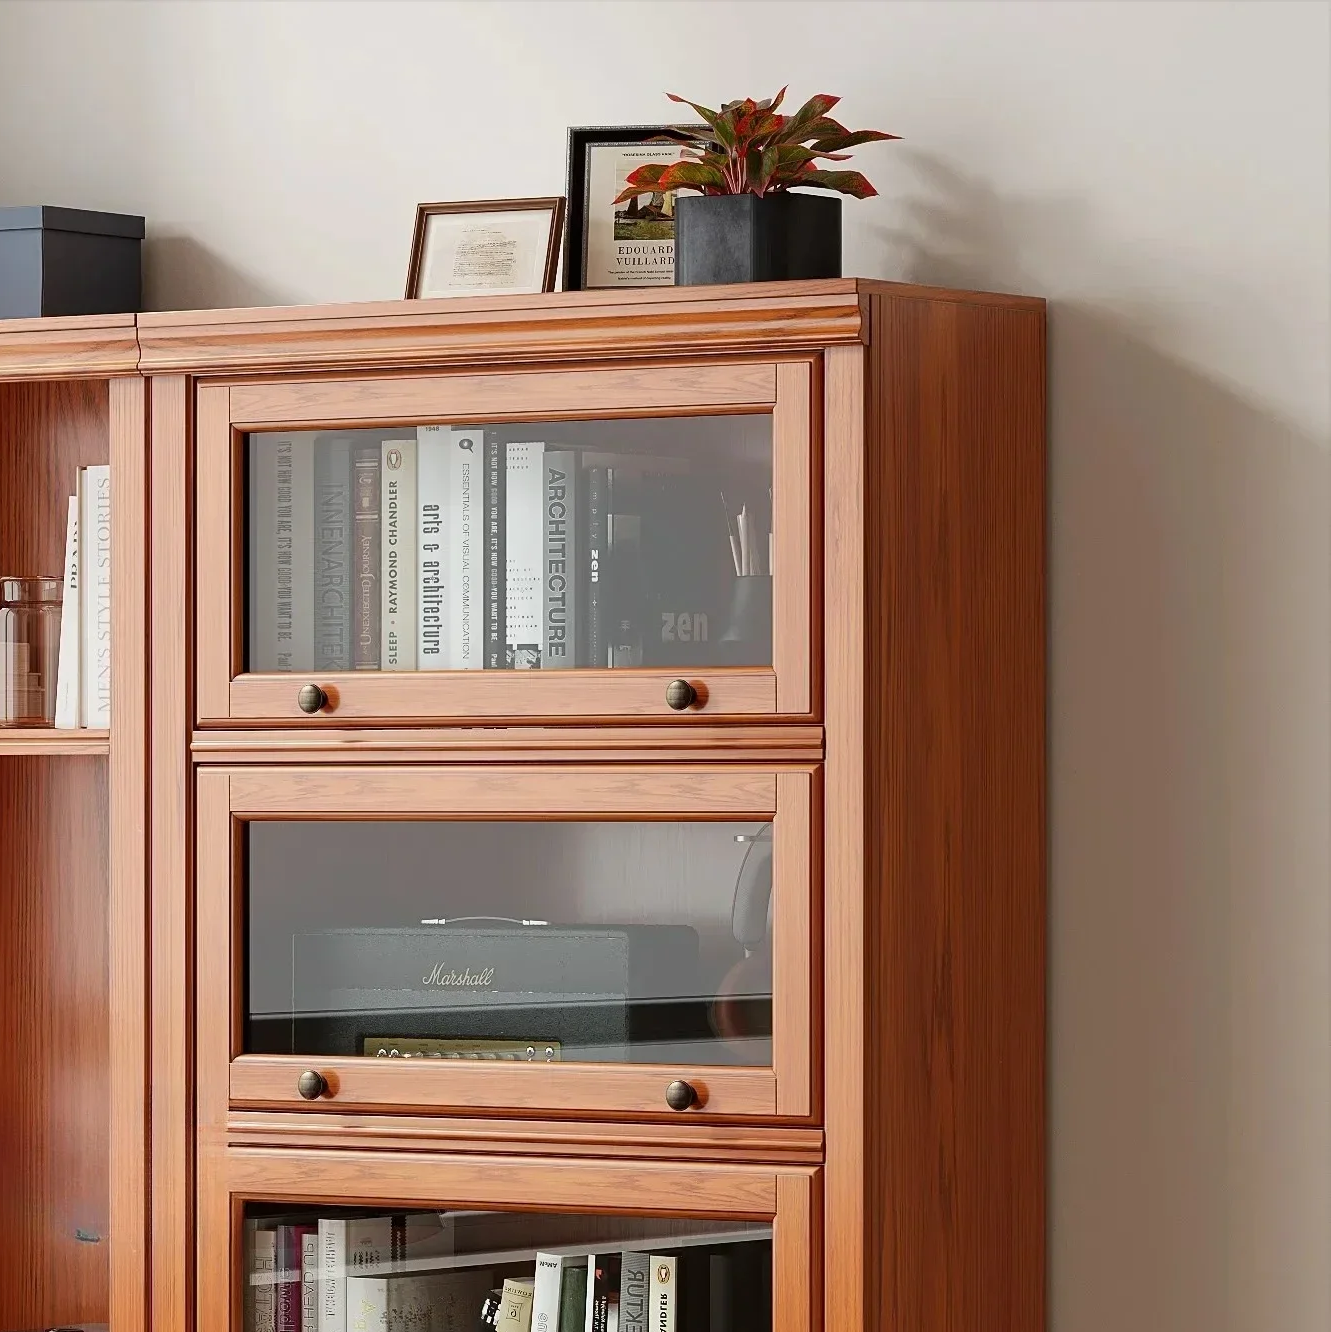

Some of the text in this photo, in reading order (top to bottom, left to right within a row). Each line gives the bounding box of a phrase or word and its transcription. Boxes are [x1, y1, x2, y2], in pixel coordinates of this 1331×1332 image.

[618, 245, 674, 255] EDOUARD
[616, 256, 675, 266] VUILLARD
[490, 442, 498, 455] IT'S
[276, 455, 293, 467] NOT
[490, 457, 498, 469] NOT
[276, 469, 293, 484] HOW
[490, 471, 498, 486] HOW
[276, 486, 293, 502] GOOD
[276, 506, 293, 518] YOU
[422, 504, 444, 534] arts
[490, 507, 498, 519] YOU
[276, 520, 293, 534] ARE,
[490, 521, 498, 536] ARE,
[490, 538, 498, 550] IT'S
[276, 551, 293, 565] HOW
[462, 463, 470, 660] ESSENTIALS OF VISUAL COMMUNICATION
[490, 552, 498, 566] HOW
[547, 467, 566, 657] ARCHITECTURE
[388, 480, 398, 665] SLEEP RAYMOND CHANDLER
[591, 549, 599, 583] zen
[320, 484, 344, 670] INNENARCHITEK
[97, 478, 111, 712] MEN'S STYLE STORIES
[490, 587, 498, 600] YOU
[276, 601, 293, 619] WANT
[422, 561, 444, 655] architecture
[490, 602, 498, 620] WANT
[276, 621, 293, 629] TO
[490, 622, 498, 631] TO
[661, 612, 709, 642] zen
[276, 653, 293, 666] Paul
[490, 654, 498, 668] Paul
[422, 961, 495, 986] Marshall
